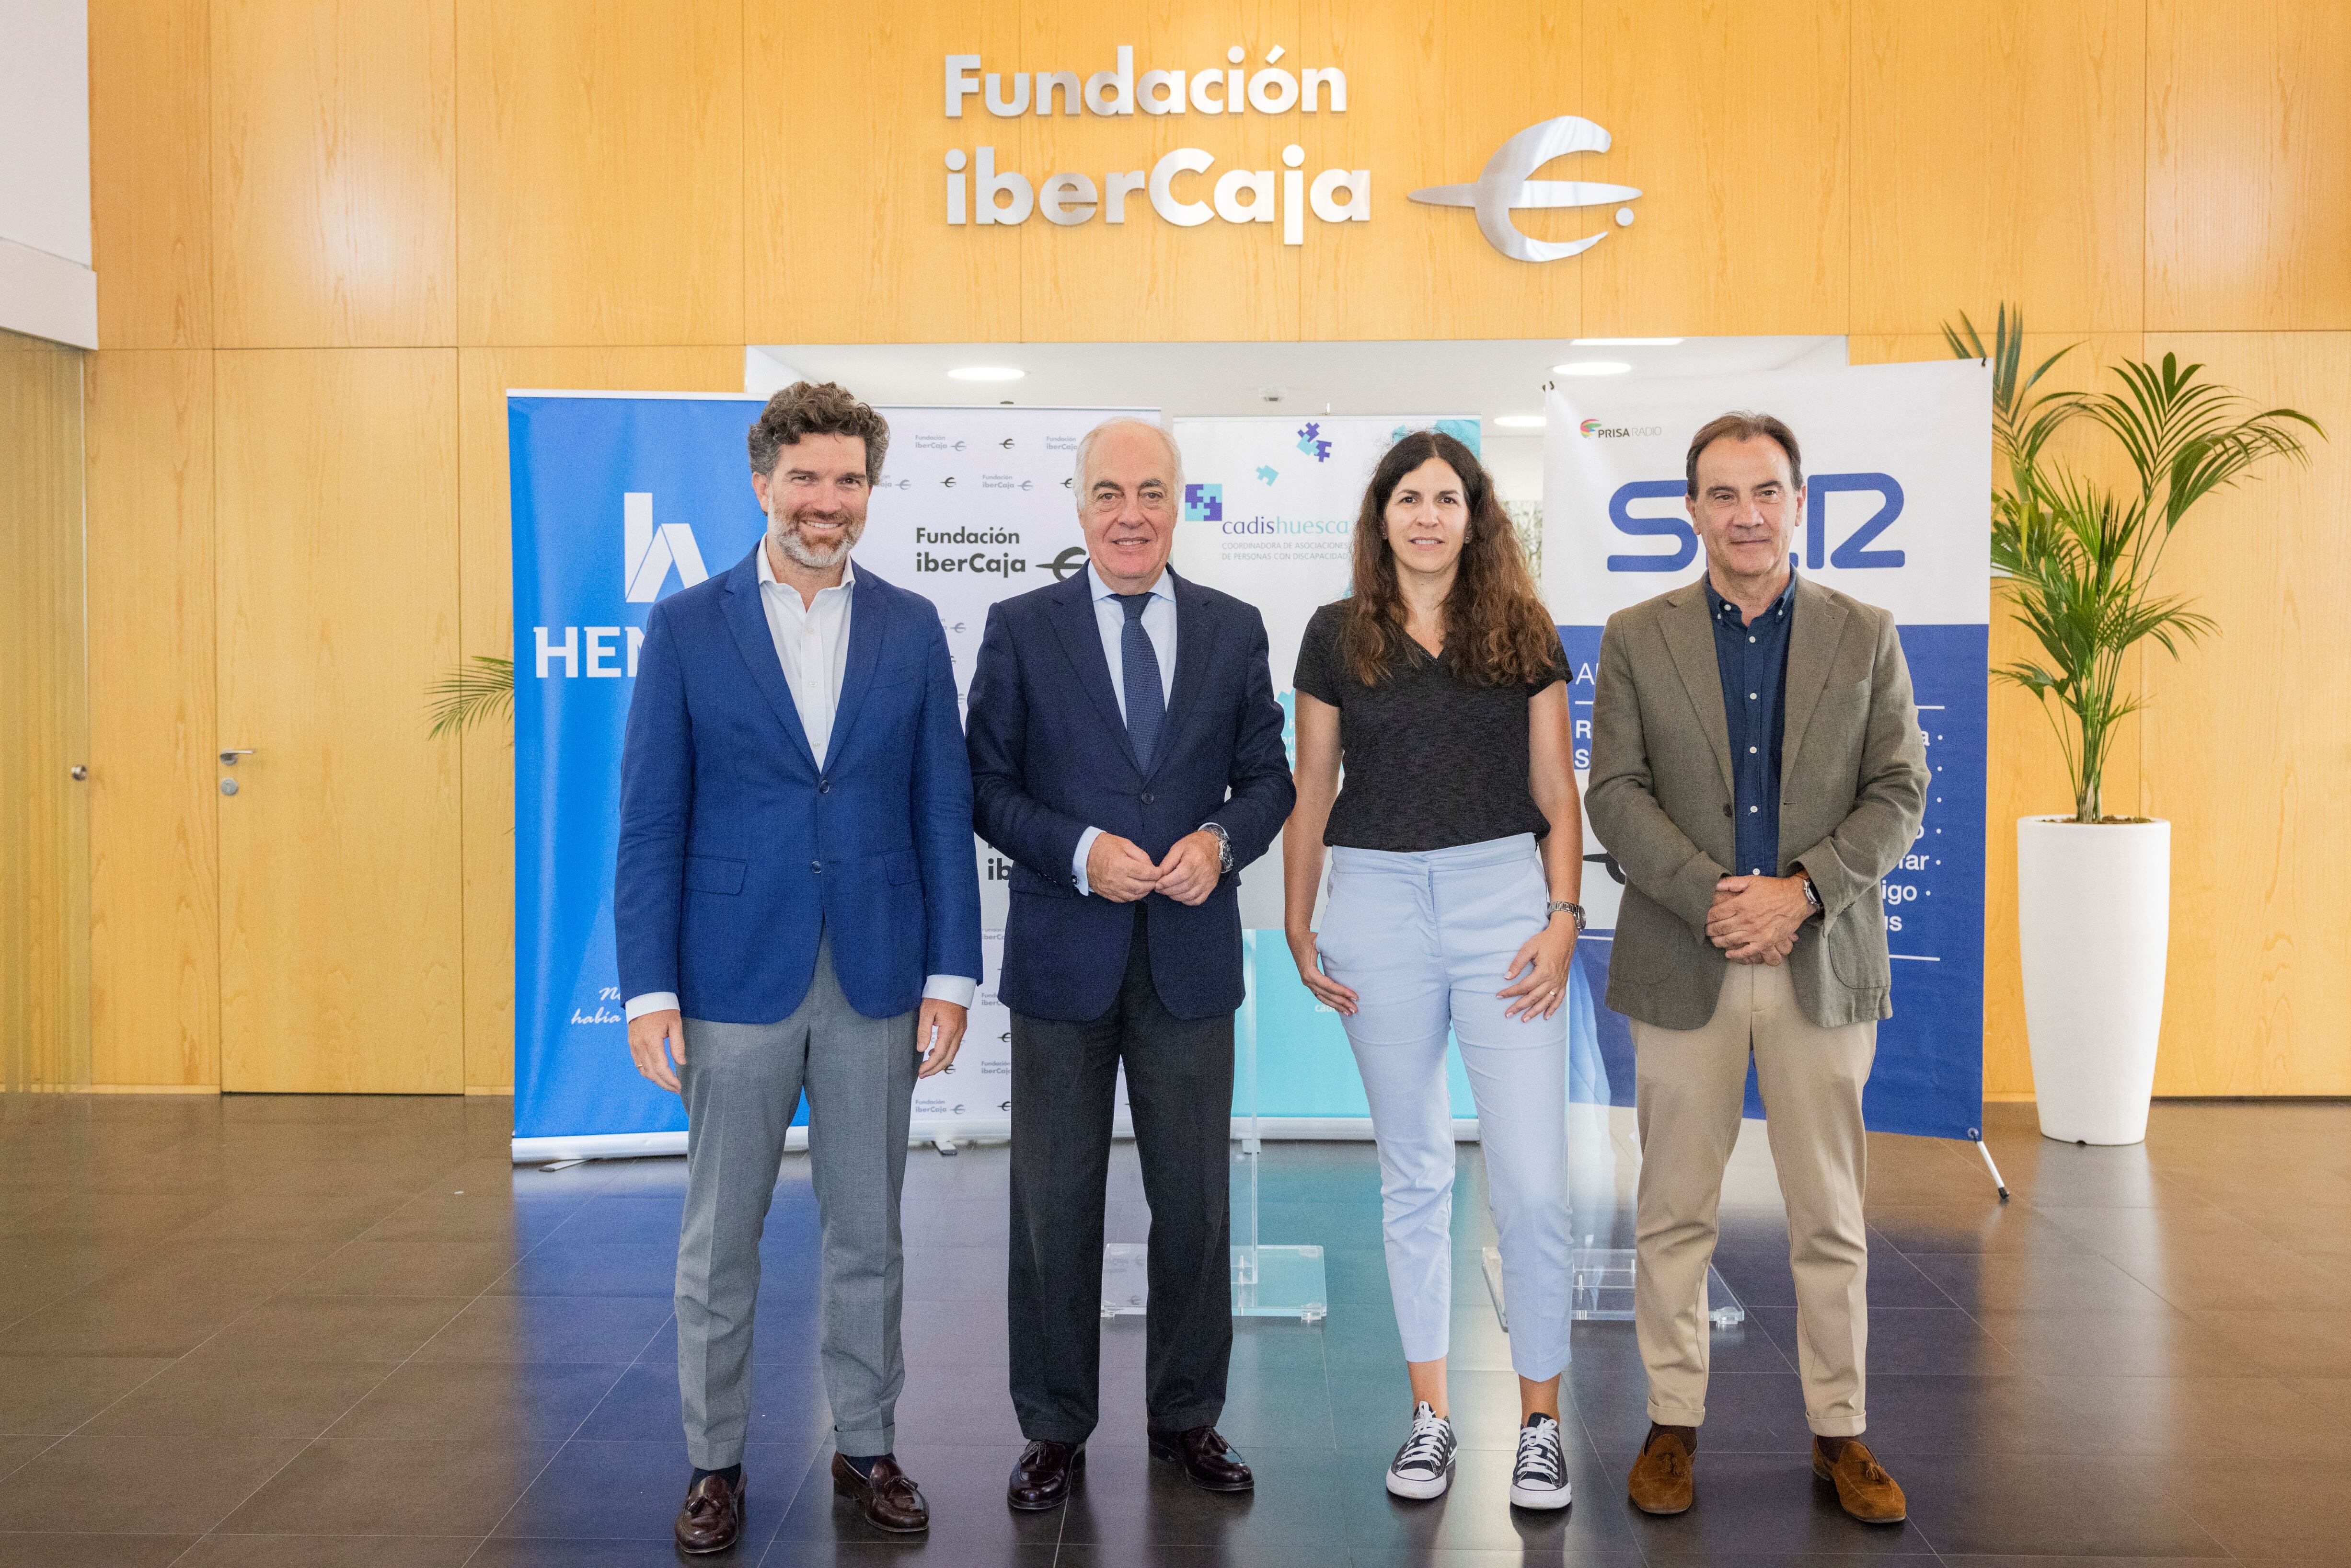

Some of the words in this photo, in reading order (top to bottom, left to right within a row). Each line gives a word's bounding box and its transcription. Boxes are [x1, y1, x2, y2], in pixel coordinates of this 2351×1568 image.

[945, 45, 1347, 117] Fundación
[945, 144, 1371, 245] iberCaja
[1598, 428, 1629, 438] PRISA
[1632, 427, 1662, 437] RADIO
[916, 526, 1020, 544] Fundación
[1222, 516, 1349, 534] cadishuesca
[1607, 473, 1905, 572] SR
[916, 552, 1026, 578] iberCaja
